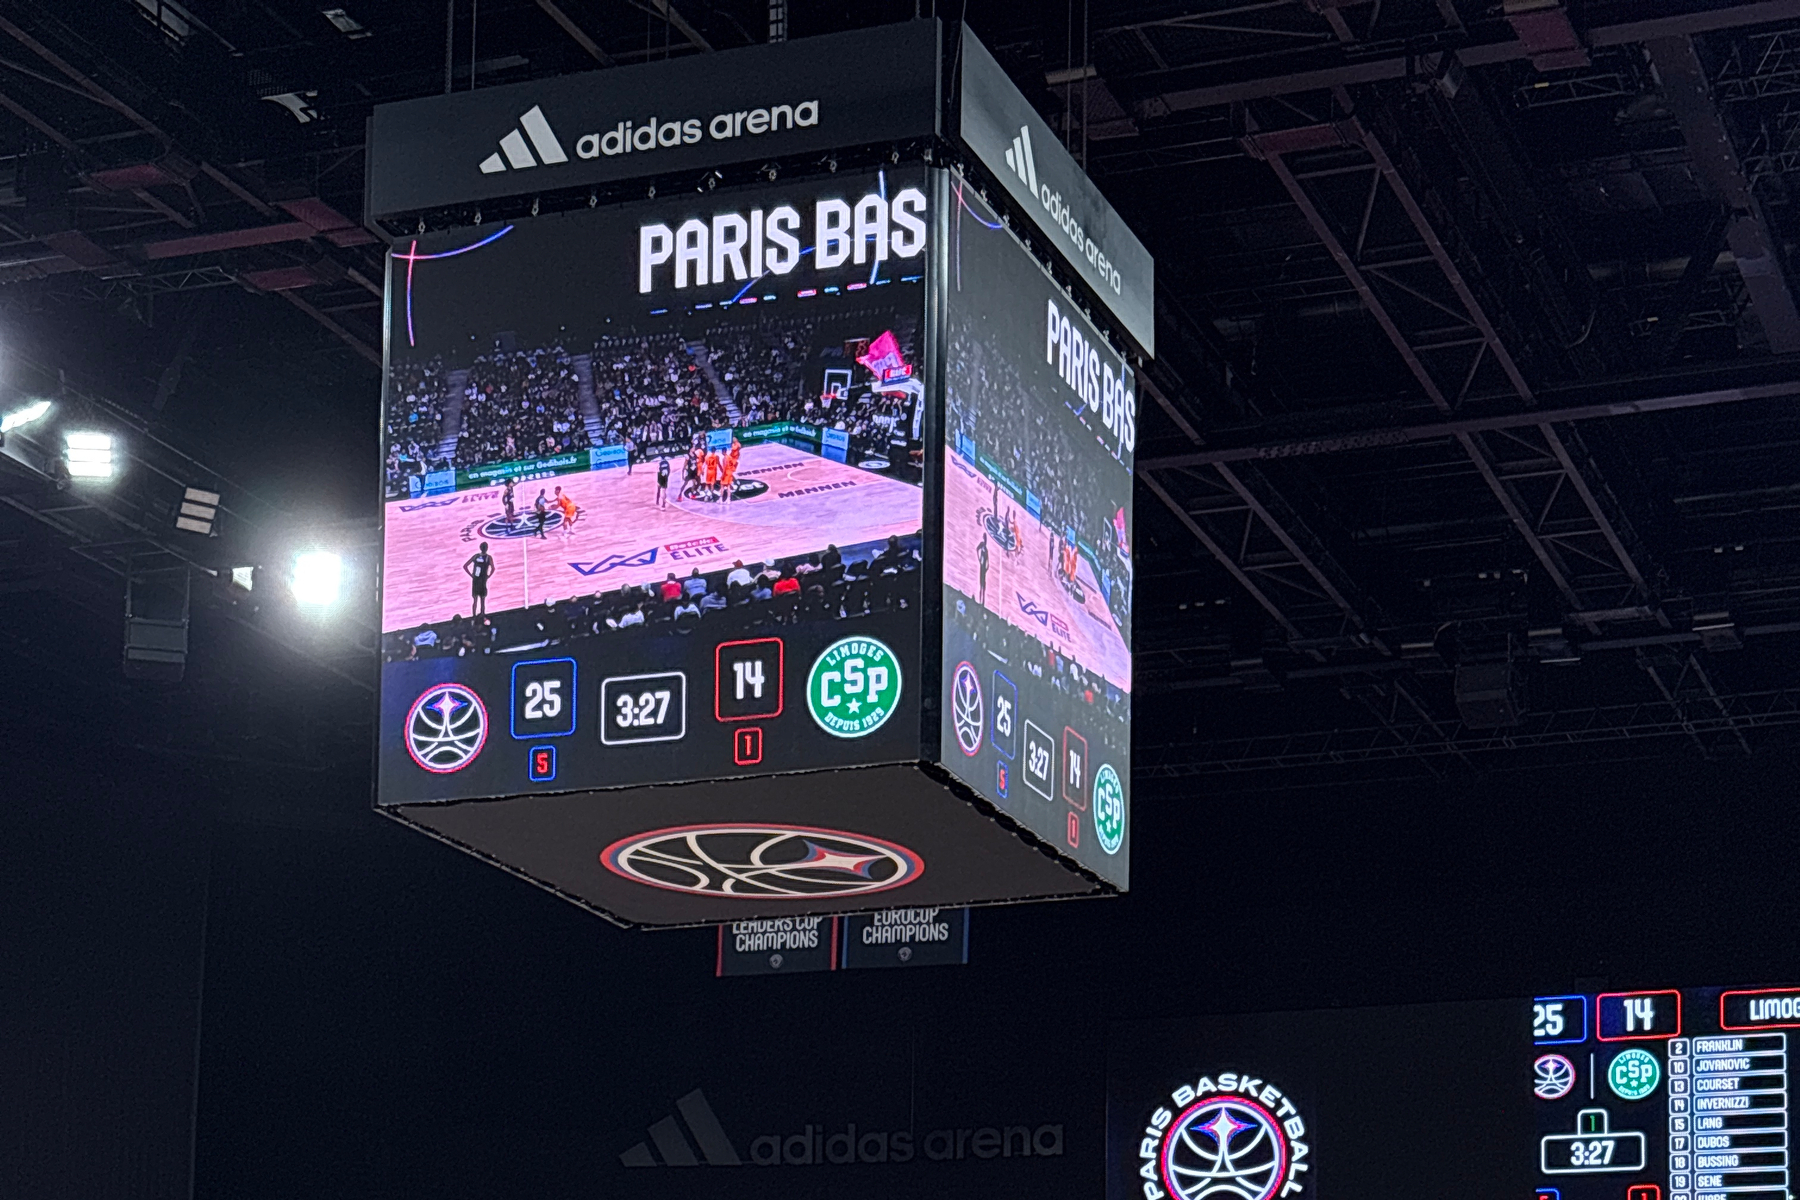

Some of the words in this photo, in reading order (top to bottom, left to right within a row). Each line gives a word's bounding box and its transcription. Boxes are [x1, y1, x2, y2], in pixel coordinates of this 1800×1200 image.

[576, 116, 703, 161] adidas
[709, 100, 820, 141] arena
[639, 204, 801, 294] PARIS
[813, 188, 927, 269] BAS
[1041, 184, 1084, 252] adidas
[1085, 239, 1121, 295] arena
[1047, 299, 1100, 413] PARIS
[1102, 361, 1136, 453] BAS
[826, 642, 884, 667] LIMOGES
[733, 660, 765, 700] 14
[821, 657, 889, 708] CSP
[524, 680, 562, 720] 25
[616, 689, 672, 728] 3:27
[824, 710, 861, 731] DEPUIS
[862, 706, 885, 730] 1929
[996, 695, 1012, 738] 25
[744, 734, 752, 756] 1
[536, 753, 548, 774] 5
[1028, 740, 1050, 781] 3:27
[1069, 749, 1082, 790] 14
[1098, 783, 1120, 830] CSP
[732, 917, 794, 935] LEADERS
[796, 916, 823, 931] CUP
[873, 908, 940, 926] EUROCUP
[735, 930, 819, 952] CHAMPIONS
[862, 923, 949, 945] CHAMPIONS
[1533, 1003, 1564, 1036] 25
[1623, 998, 1655, 1033] 14
[1675, 1043, 1683, 1054] 2
[1696, 1039, 1744, 1053] FRANKLIN
[1615, 1060, 1653, 1084] CSP
[1674, 1061, 1685, 1074] 10
[1696, 1058, 1751, 1072] JOVANOVIC
[1674, 1080, 1685, 1093] 13
[1696, 1077, 1740, 1091] COURSET
[1674, 1099, 1685, 1112] 14
[1697, 1096, 1750, 1110] INVERNIZZI
[1171, 1072, 1309, 1199] BASKETBALL
[1589, 1115, 1596, 1132] 1
[1674, 1118, 1685, 1131] 15
[1697, 1116, 1723, 1130] LANG
[749, 1123, 914, 1166] adidas
[923, 1123, 1064, 1160] arena
[1570, 1140, 1615, 1166] 3:27
[1674, 1137, 1685, 1150] 17
[1697, 1135, 1730, 1149] DUBOS
[1674, 1156, 1686, 1168] 18
[1698, 1154, 1739, 1168] BUSSING
[1674, 1175, 1686, 1188] 19
[1698, 1174, 1723, 1188] SENE
